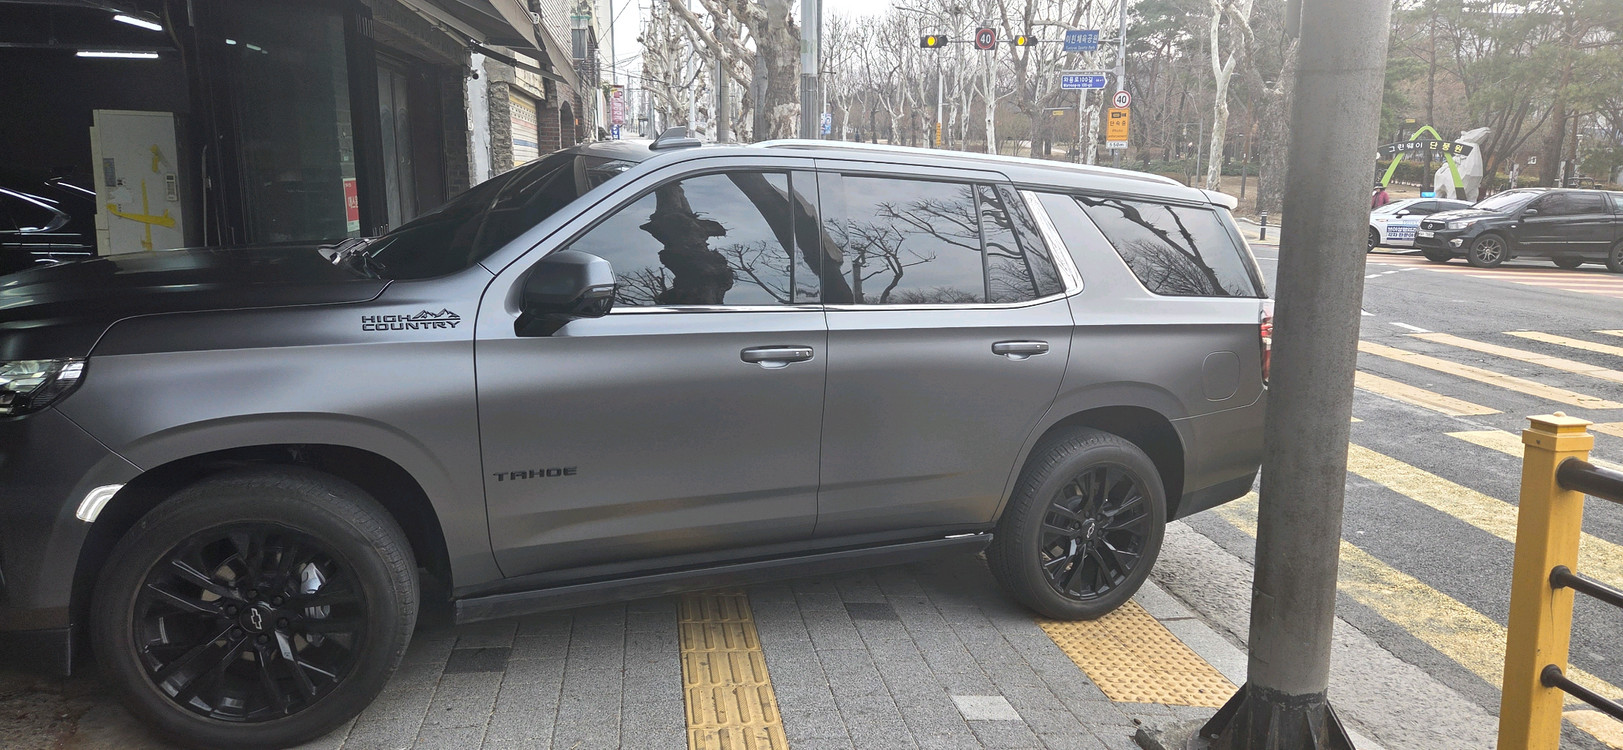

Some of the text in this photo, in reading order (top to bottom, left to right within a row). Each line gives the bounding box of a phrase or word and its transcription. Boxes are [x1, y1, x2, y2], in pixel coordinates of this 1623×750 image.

[981, 34, 991, 43] 40
[1117, 95, 1127, 104] 40
[1388, 141, 1464, 154] 그린웨이 단풍원
[361, 314, 411, 323] HIGH
[361, 321, 461, 331] COUNTRY
[493, 466, 578, 482] TAHOE
